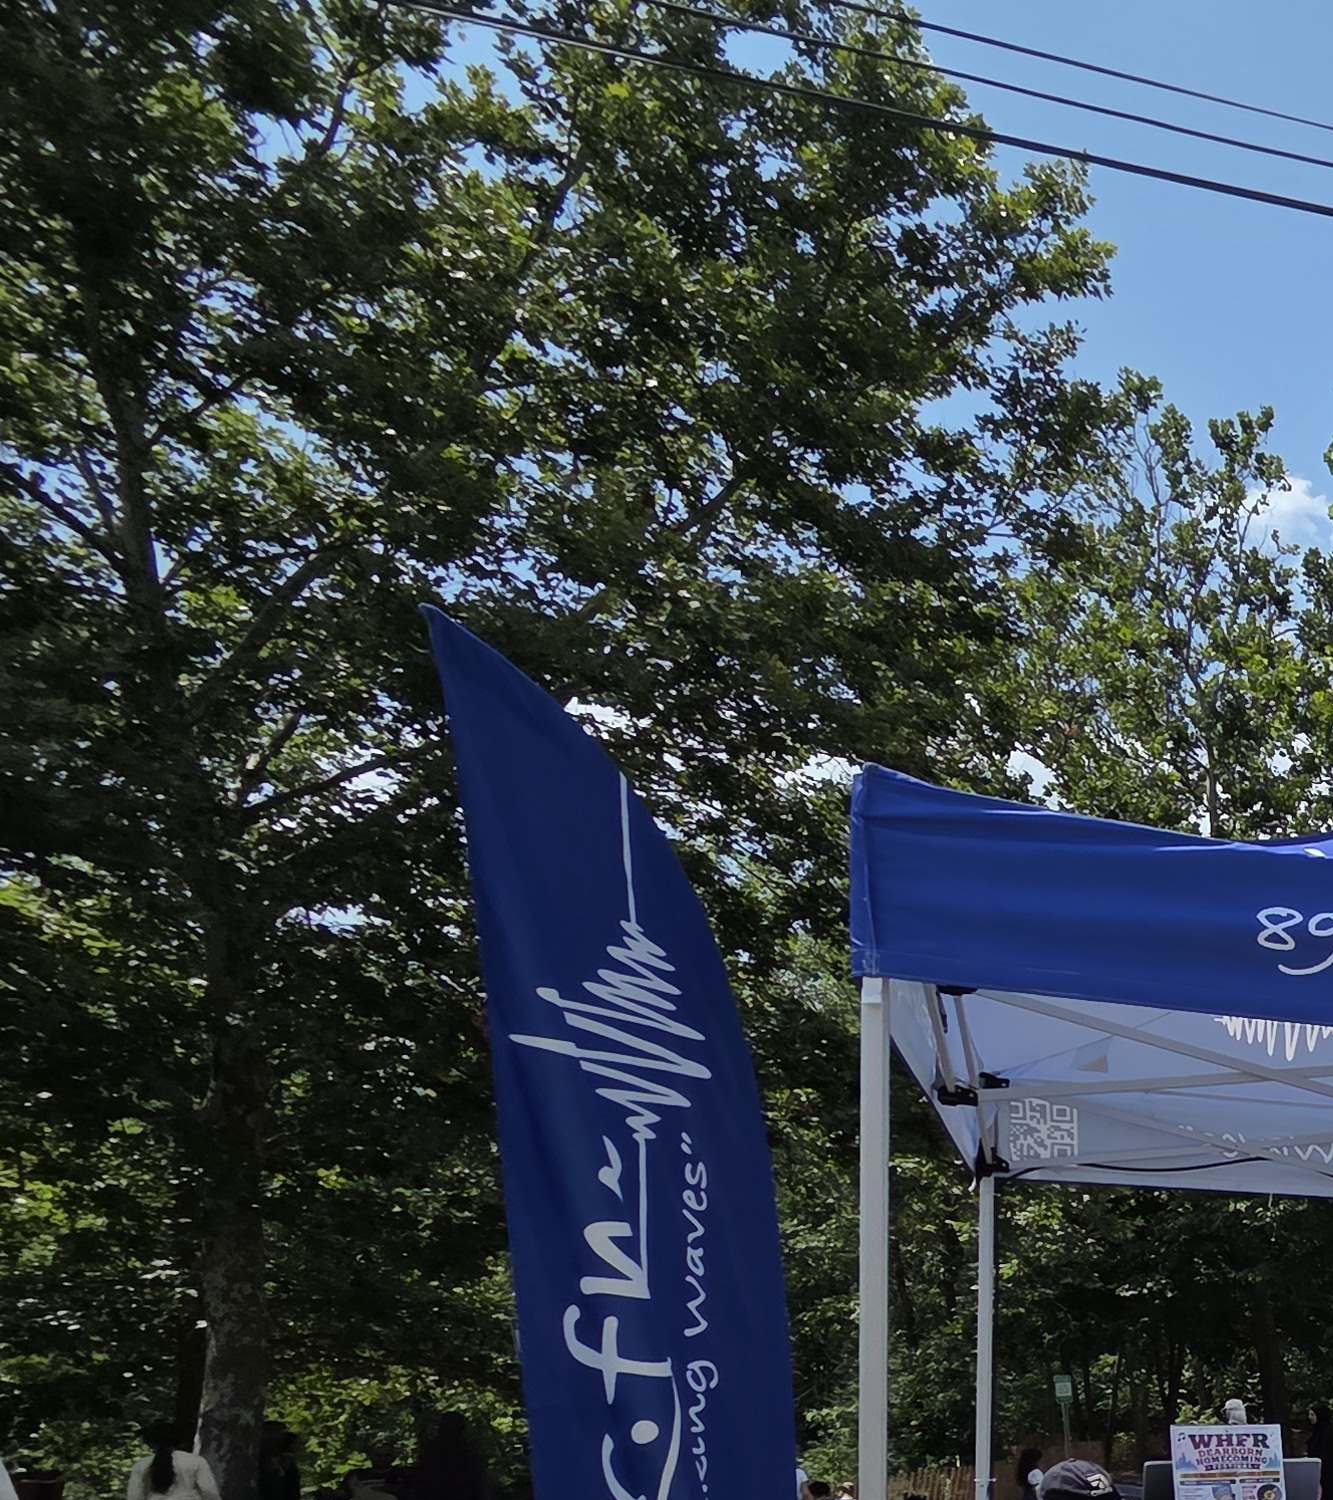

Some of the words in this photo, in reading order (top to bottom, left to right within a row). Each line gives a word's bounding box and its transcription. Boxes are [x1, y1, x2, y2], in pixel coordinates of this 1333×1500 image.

[1188, 1433, 1270, 1450] WHFR
[1198, 1447, 1263, 1458] DEARBORN
[1196, 1455, 1267, 1466] HOMECOMING
